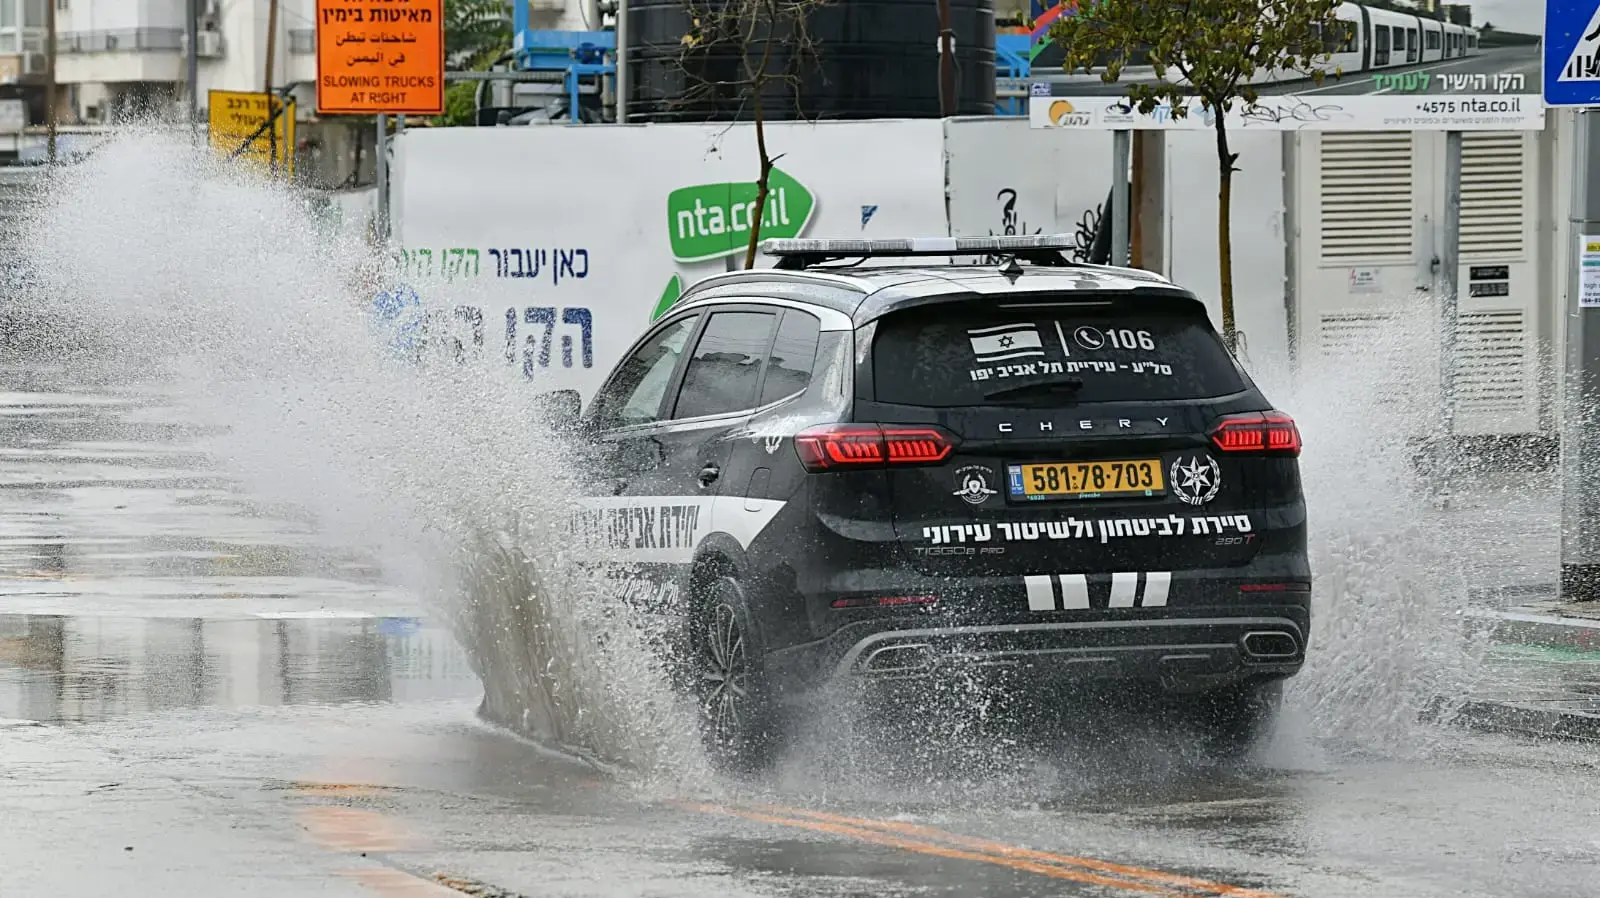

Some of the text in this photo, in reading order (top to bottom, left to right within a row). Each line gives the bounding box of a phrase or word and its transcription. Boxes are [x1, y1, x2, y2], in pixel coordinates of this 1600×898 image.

[322, 8, 432, 24] מאיטות בימין
[323, 75, 434, 88] SLOWING TRUCKS
[1372, 71, 1525, 93] הקו הישיר לעתיד
[351, 92, 407, 104] AT RIGHT
[1460, 97, 1521, 113] nta.co.il
[677, 187, 790, 239] nta.co.il
[441, 247, 480, 283] הקו
[486, 248, 546, 278] יעבור
[551, 248, 588, 285] כאן
[504, 307, 593, 382] הקו
[1106, 328, 1155, 350] 106
[970, 368, 993, 381] יפו
[996, 365, 1037, 377] אביב
[1038, 361, 1063, 374] תל
[1066, 361, 1116, 374] עיריית
[999, 417, 1169, 432] CHERY
[1010, 475, 1021, 487] IL
[660, 505, 701, 549] יחידת
[922, 514, 1252, 544] סיירת לביטחון ולשיטור עירוני
[1215, 534, 1256, 546] 290T
[980, 547, 1005, 555] PRO
